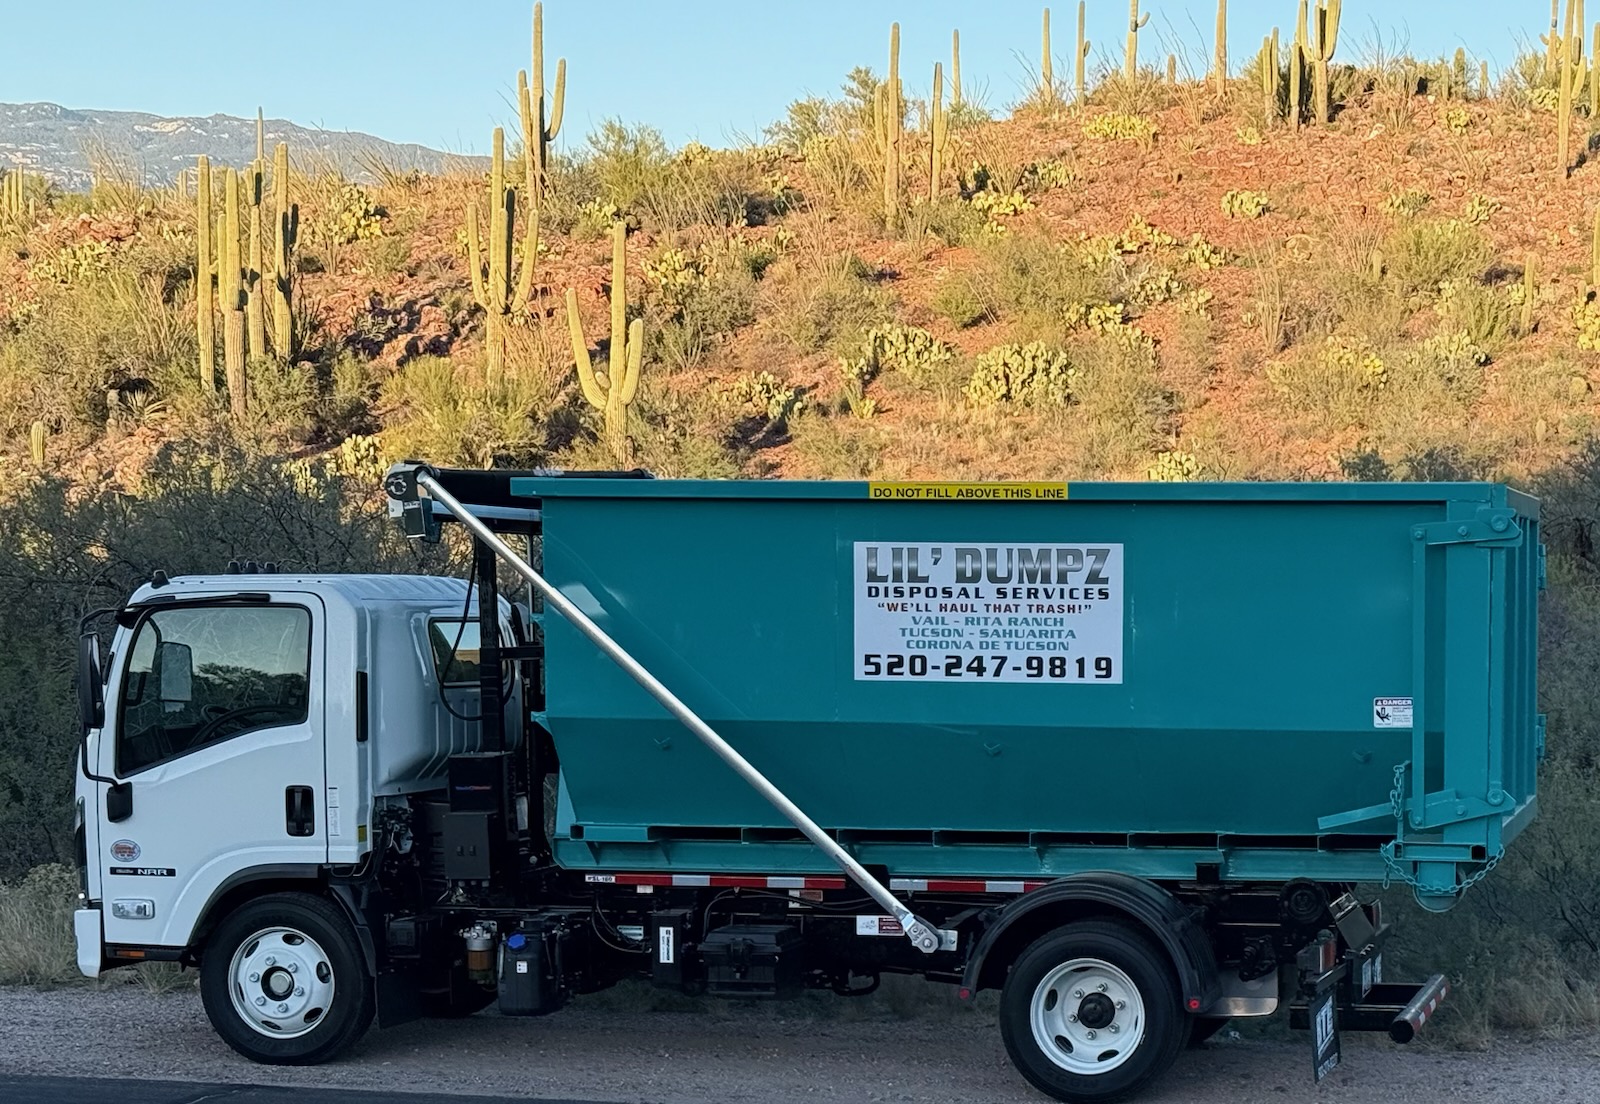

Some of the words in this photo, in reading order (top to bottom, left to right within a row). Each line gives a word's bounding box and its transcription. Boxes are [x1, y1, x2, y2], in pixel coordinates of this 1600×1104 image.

[873, 487, 892, 498] DO
[896, 488, 922, 498] NOT
[926, 488, 952, 498] FILL
[956, 488, 1001, 498] ABOVE
[1003, 488, 1032, 499] THIS
[1035, 488, 1065, 499] LINE
[866, 547, 942, 583] LIL'
[955, 547, 1111, 585] DUMPZ
[867, 586, 985, 599] DISPOSAL
[996, 587, 1110, 600] SERVICES
[939, 603, 978, 613] HAUL
[984, 604, 1021, 614] THAT
[1027, 604, 1092, 615] TRASH!"
[911, 616, 950, 627] VAIL
[964, 616, 1003, 627] RITA
[1007, 616, 1065, 628] RANCH
[899, 627, 964, 639] TUCSON
[979, 628, 1077, 640] SAHUARITA
[906, 639, 975, 651] CORONA
[978, 640, 1000, 651] DE
[1003, 640, 1070, 652] TUCSON
[864, 654, 1113, 680] 520-247-9819
